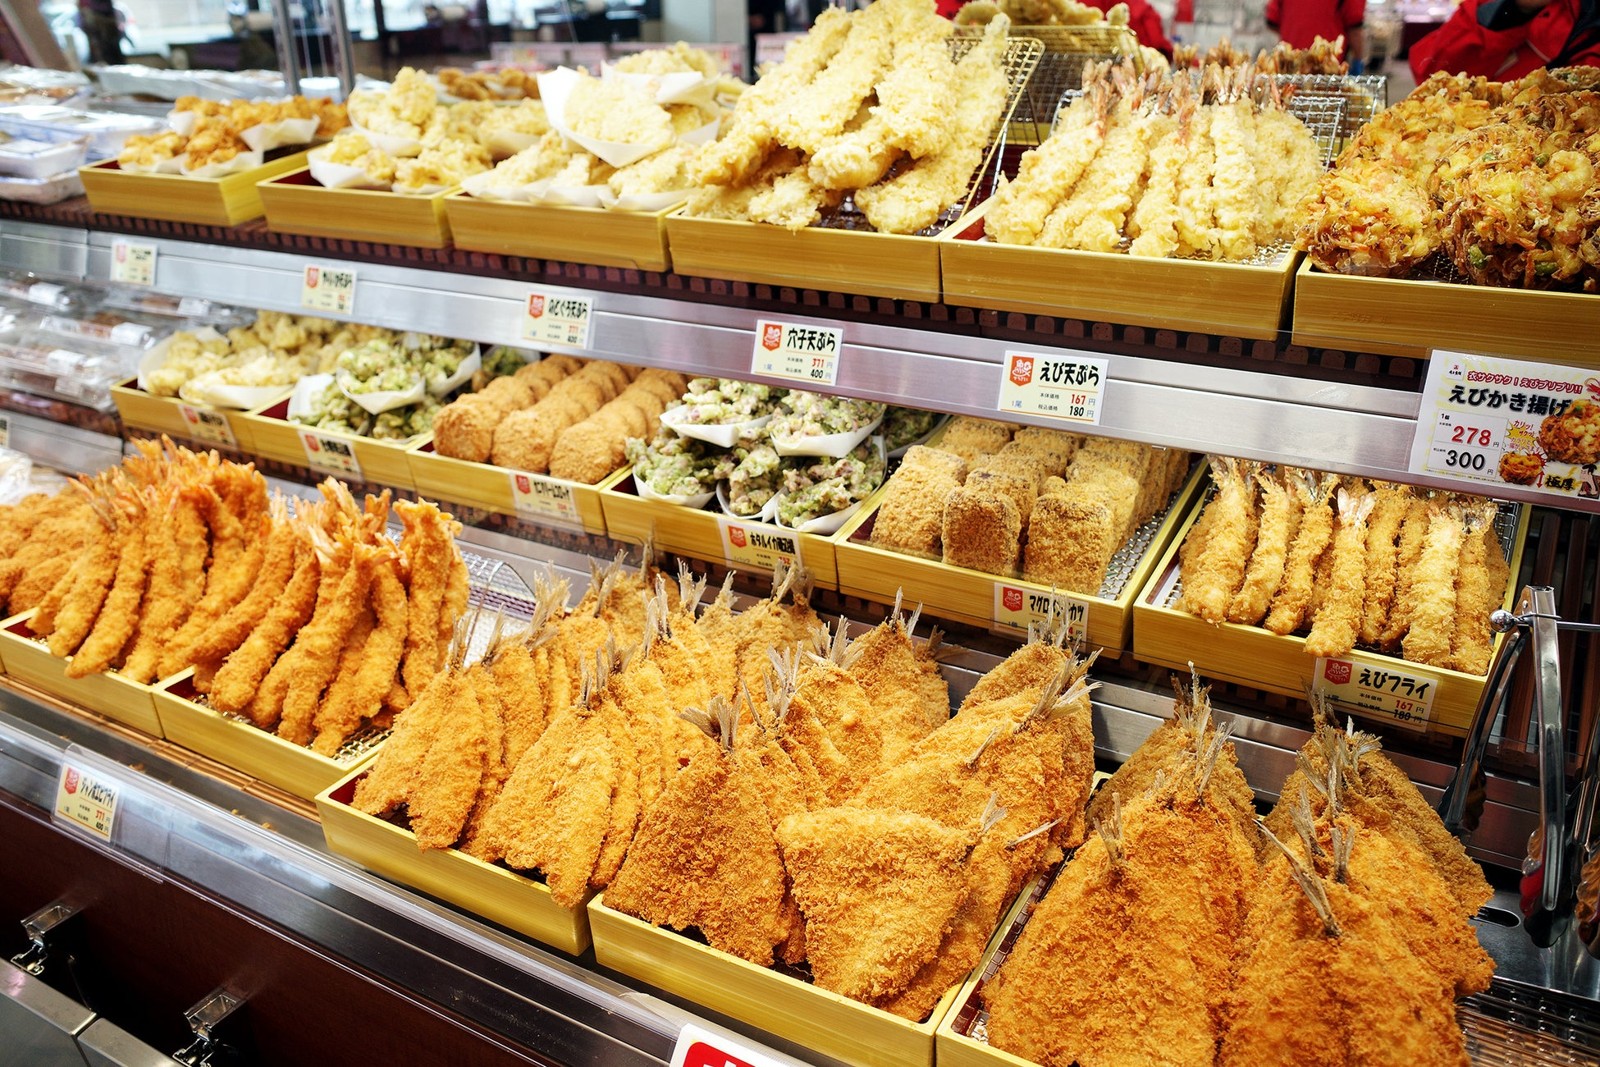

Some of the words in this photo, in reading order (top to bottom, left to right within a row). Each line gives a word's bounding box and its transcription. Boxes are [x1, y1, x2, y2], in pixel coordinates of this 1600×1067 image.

[787, 328, 836, 352] 穴子天ぷら
[810, 369, 824, 378] 400
[811, 358, 825, 368] 371
[1040, 361, 1100, 387] えび天ぷら
[1040, 392, 1060, 400] 本体価格
[1071, 394, 1087, 405] 167
[1088, 398, 1096, 406] 円
[1448, 384, 1572, 418] えびかき揚げ
[1069, 405, 1085, 417] 180
[1086, 410, 1095, 418] 円
[1451, 425, 1492, 448] 278
[1445, 449, 1486, 471] 300
[1487, 468, 1494, 476] 円
[1029, 595, 1085, 622] マグロカツ
[1358, 668, 1430, 699] えびフライ
[1360, 693, 1383, 702] 本体価格
[1395, 699, 1414, 712] 167
[1415, 705, 1424, 714] 円
[1394, 709, 1412, 721] 180
